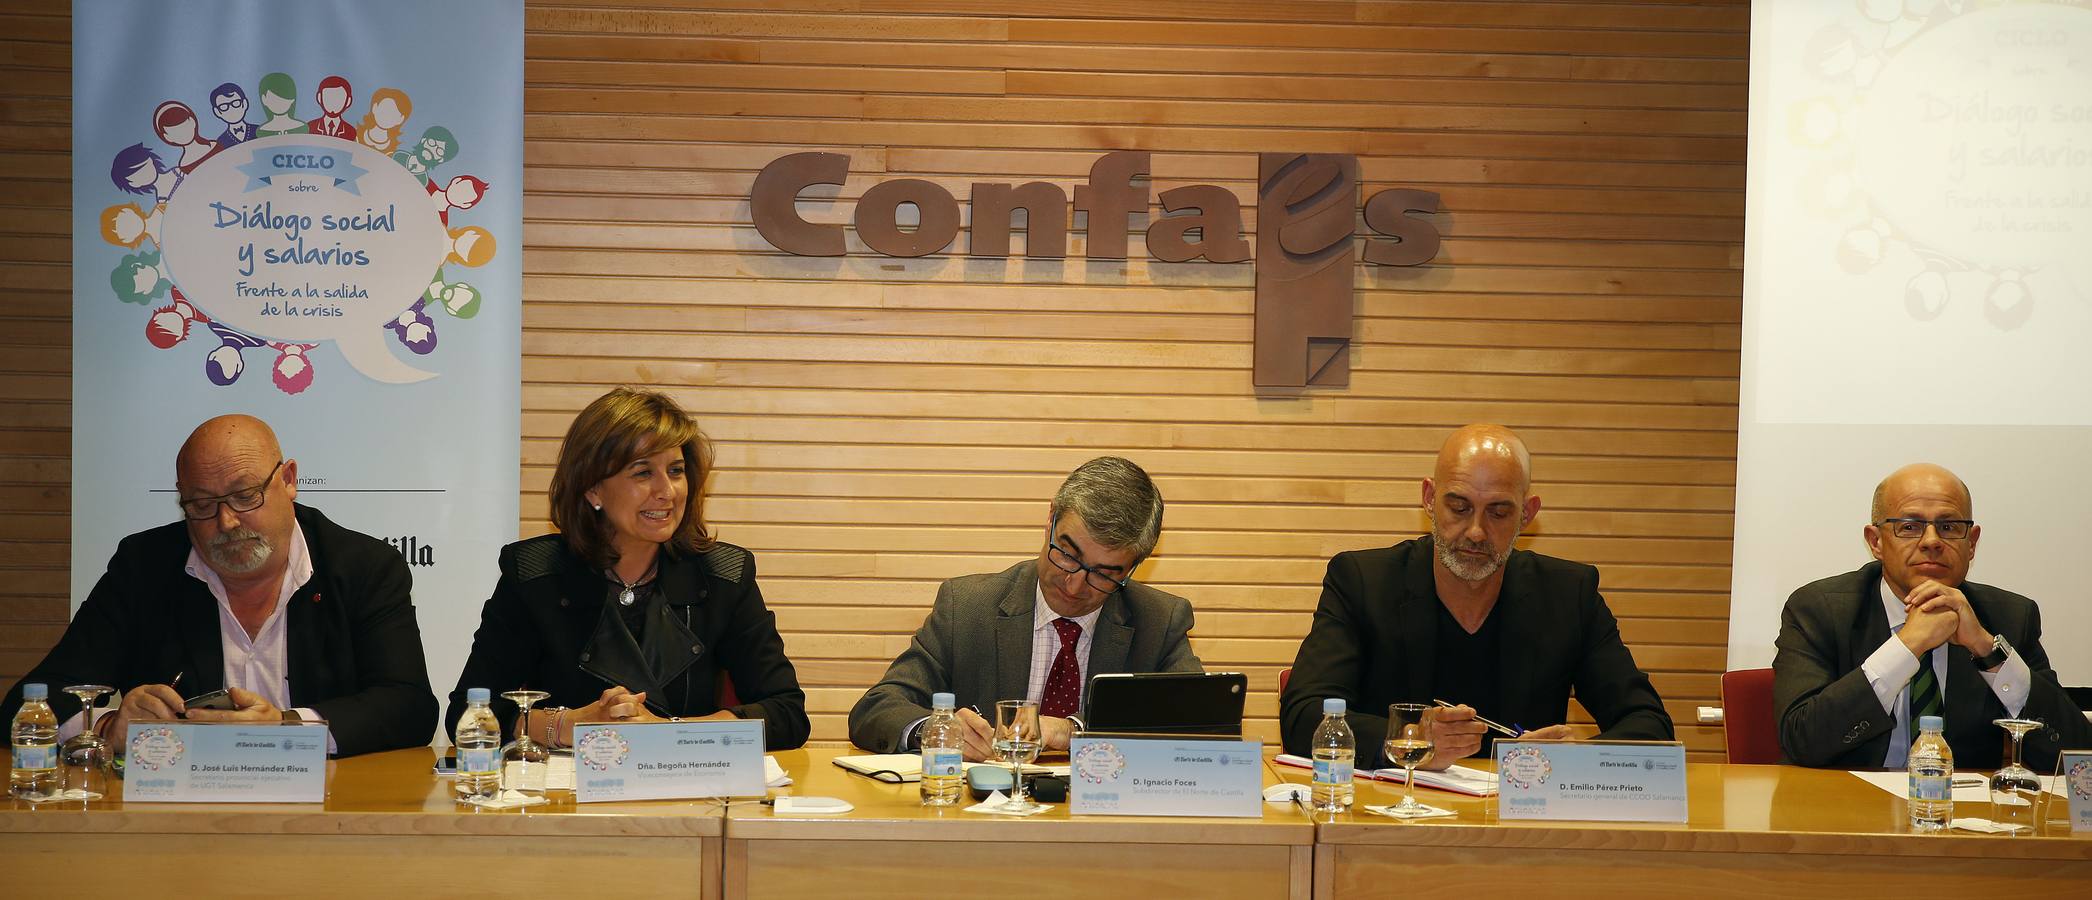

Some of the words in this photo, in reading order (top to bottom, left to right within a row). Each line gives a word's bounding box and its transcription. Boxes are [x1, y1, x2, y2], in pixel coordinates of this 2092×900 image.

[272, 154, 335, 170] CICLO
[288, 182, 319, 193] sobre
[210, 201, 312, 240] Diálogo
[322, 204, 396, 233] social
[750, 151, 1441, 280] Confaes
[238, 243, 254, 276] y
[265, 237, 370, 268] salarios
[235, 281, 289, 299] Frente
[291, 288, 302, 299] a
[304, 282, 319, 299] la
[324, 283, 368, 299] salida
[260, 302, 281, 317] de
[284, 302, 299, 317] la
[302, 302, 344, 318] crisis
[296, 476, 326, 484] nizan:
[191, 764, 200, 772] D.
[202, 764, 221, 772] José
[222, 764, 239, 772] Luis
[240, 764, 285, 773] Hernández
[287, 765, 308, 773] Rivas
[638, 762, 656, 770] Dña.
[658, 761, 687, 771] Begoña
[688, 760, 730, 769] Hernández
[1144, 778, 1172, 787] Ignacio
[1570, 783, 1594, 791] Emilio
[1596, 784, 1618, 792] Pérez
[1620, 784, 1643, 792] Prieto
